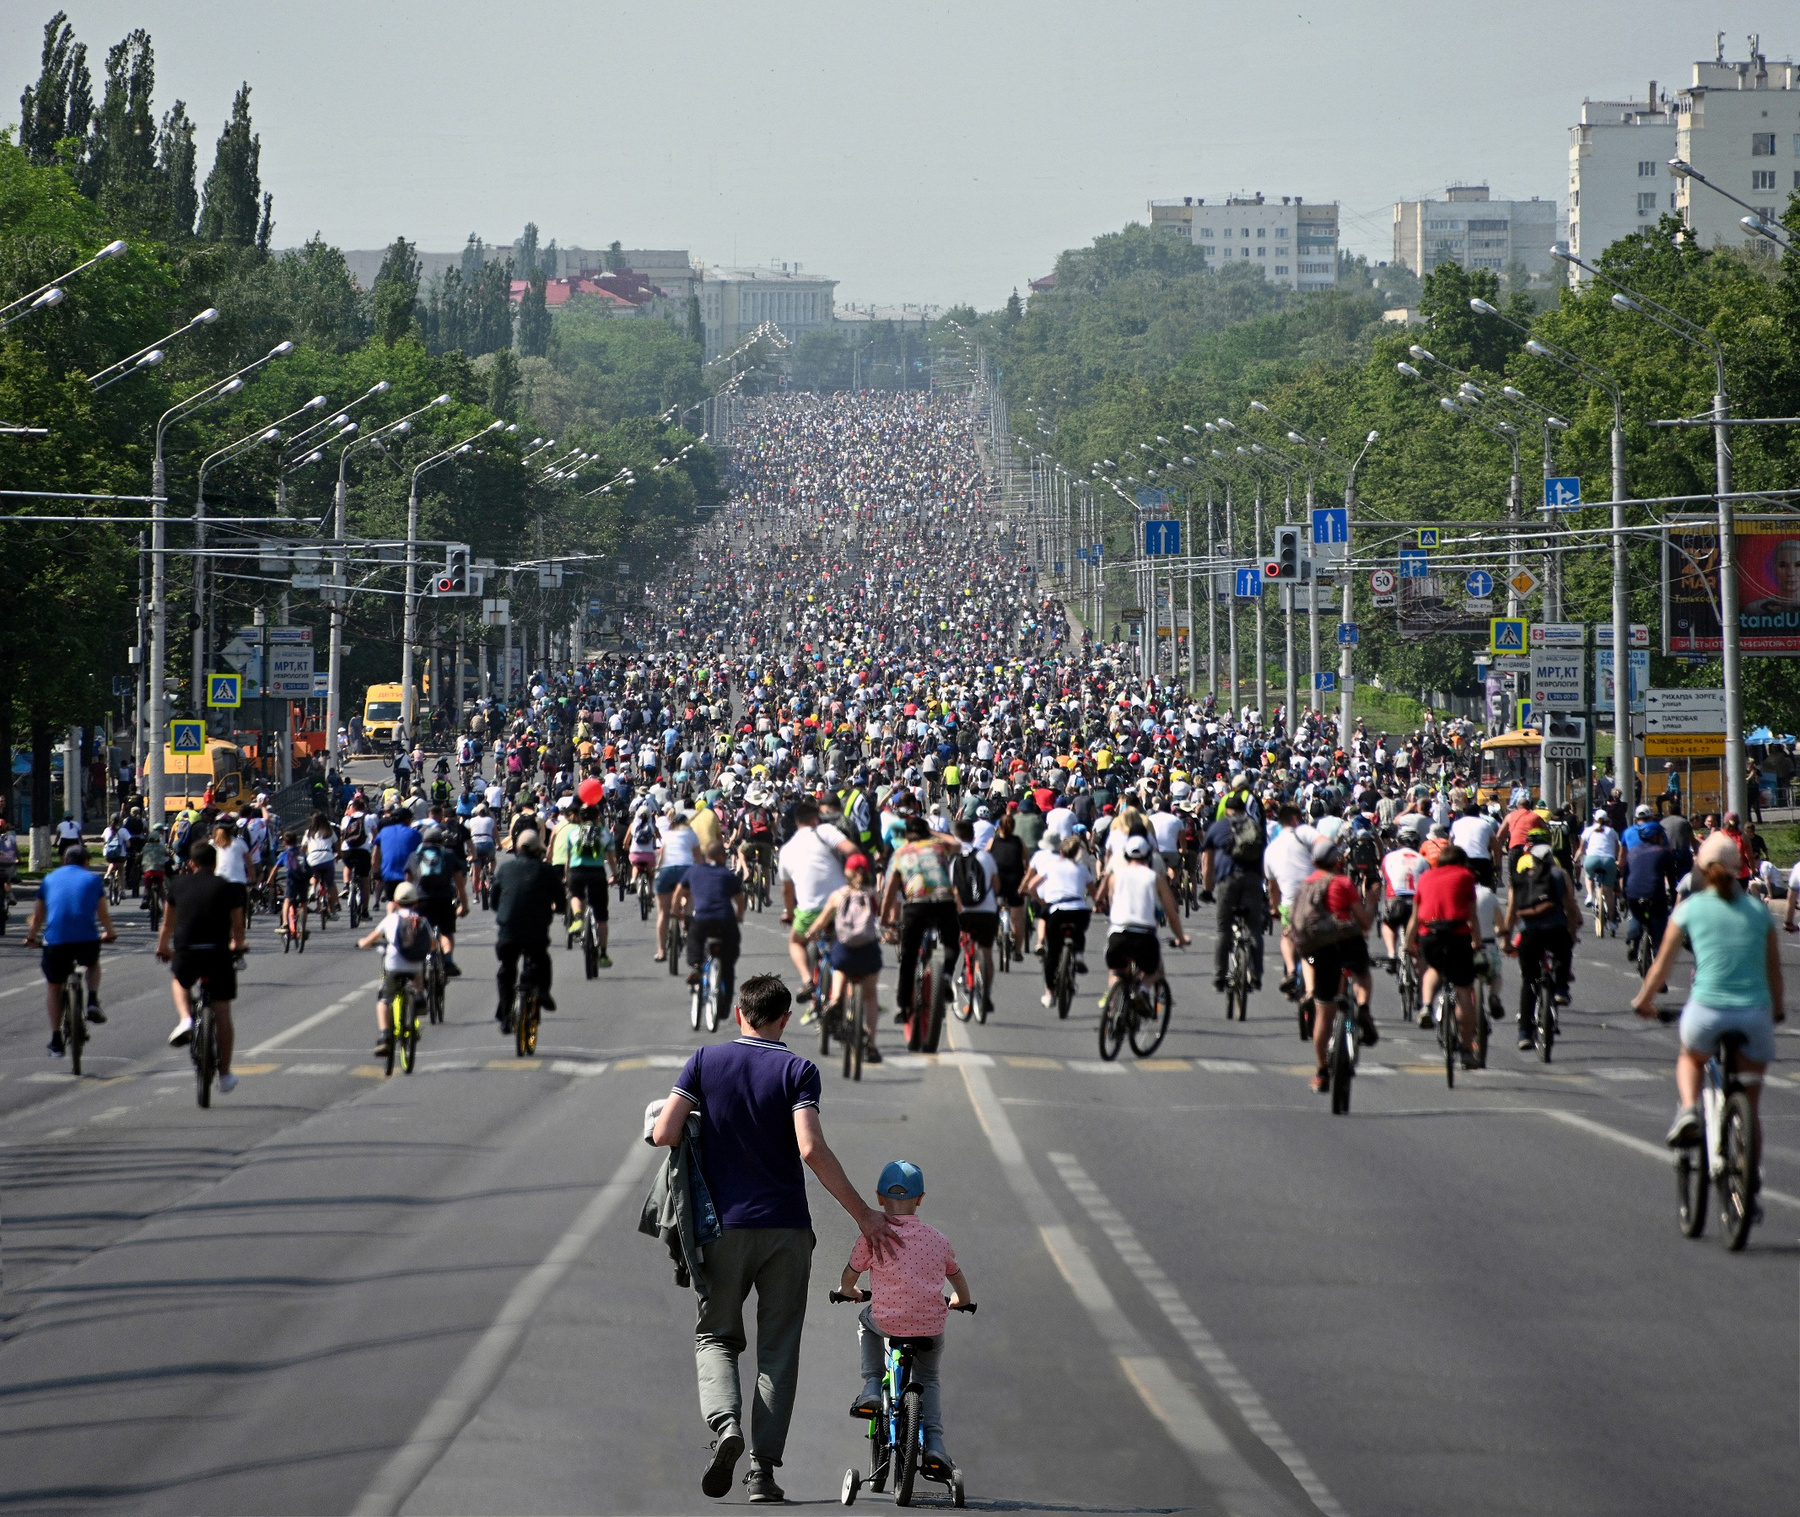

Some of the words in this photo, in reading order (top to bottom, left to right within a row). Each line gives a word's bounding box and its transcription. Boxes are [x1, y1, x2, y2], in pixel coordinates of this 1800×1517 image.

[1682, 547, 1718, 574] 27
[1375, 575, 1390, 587] 50
[1681, 576, 1717, 589] МАЯ
[1740, 611, 1799, 628] tandU
[1679, 640, 1711, 648] БИЕТЫ
[1740, 640, 1785, 648] АНИЗАТОРА
[274, 661, 309, 672] МРТ,КТ
[1537, 667, 1578, 680] МРТ,КТ
[1550, 746, 1582, 757] СТОП
